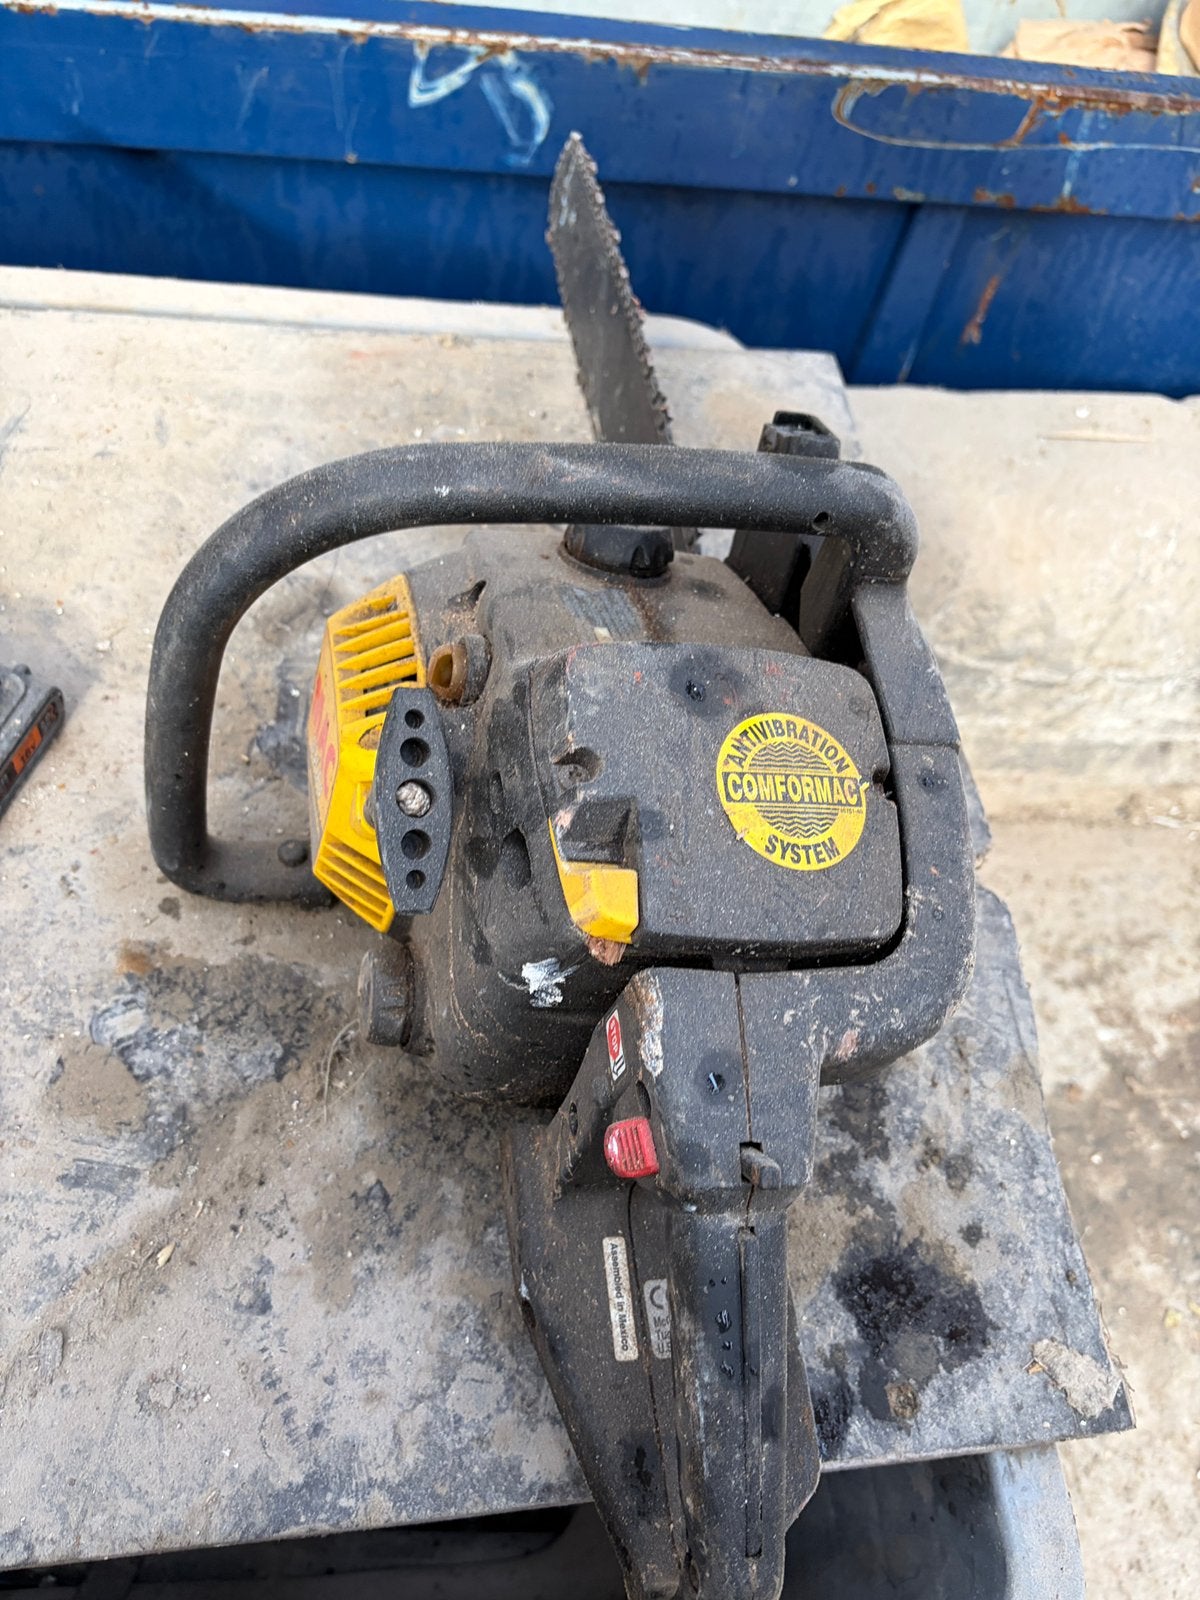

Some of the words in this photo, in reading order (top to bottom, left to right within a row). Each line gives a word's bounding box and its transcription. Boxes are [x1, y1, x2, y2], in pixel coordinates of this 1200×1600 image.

[727, 719, 851, 774] ANTIVIBRATION
[727, 773, 858, 805] COMFORMAC
[765, 834, 841, 865] SYSTEM
[609, 1019, 619, 1052] STOP
[610, 1242, 624, 1299] Assembled
[616, 1301, 624, 1311] in
[618, 1313, 629, 1352] Mexico
